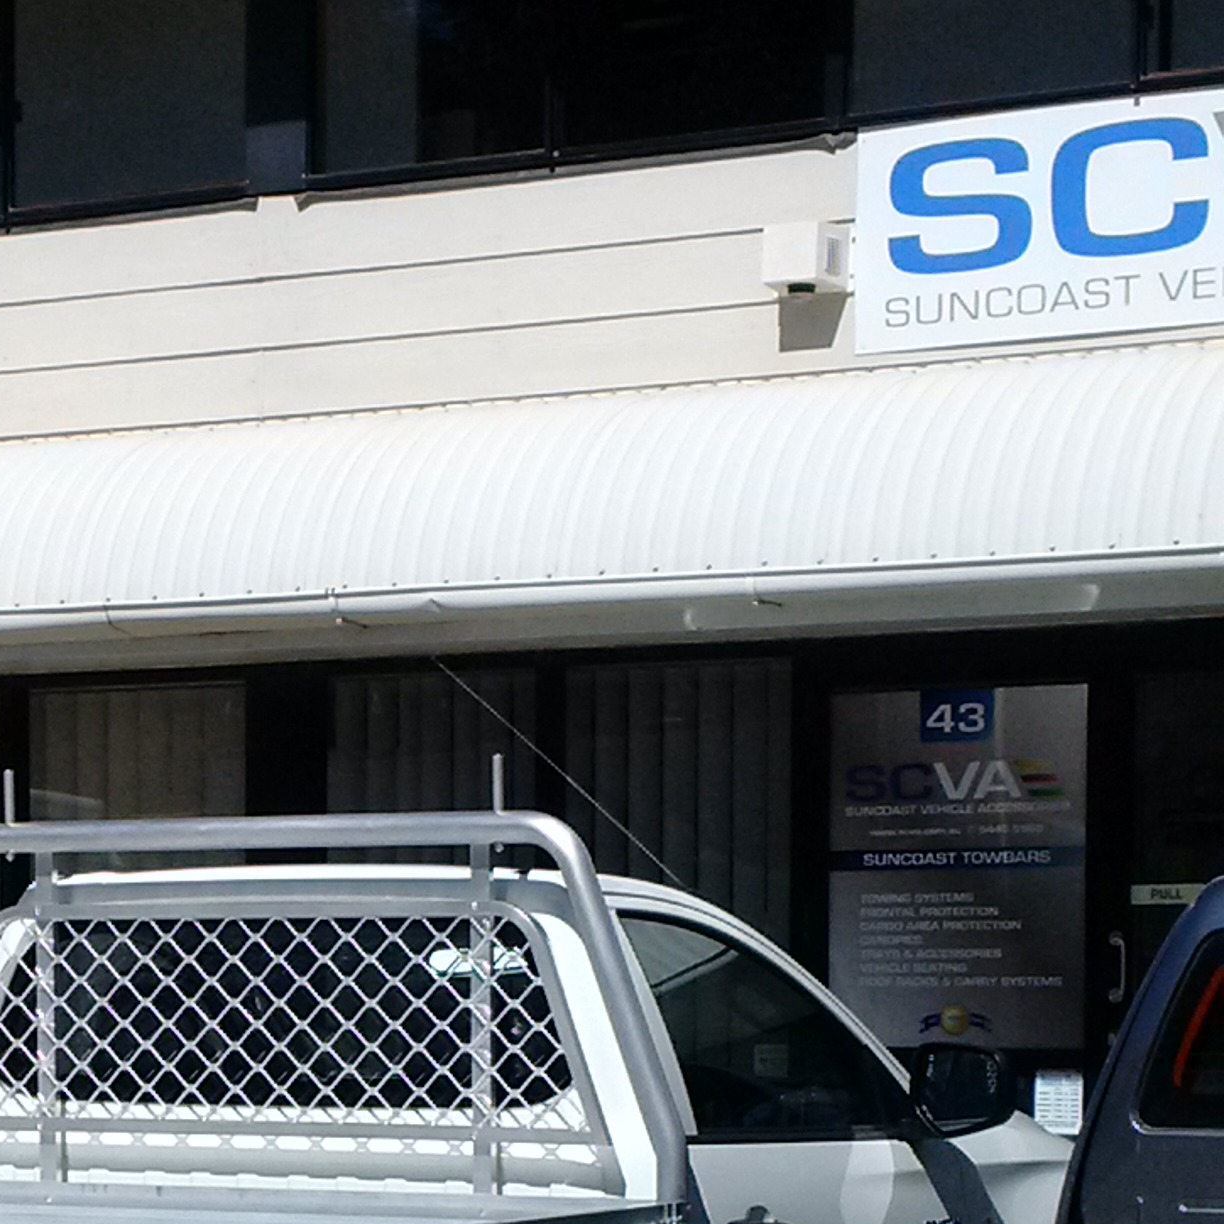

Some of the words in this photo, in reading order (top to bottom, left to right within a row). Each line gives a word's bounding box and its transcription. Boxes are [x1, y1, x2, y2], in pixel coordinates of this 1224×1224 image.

[887, 112, 1224, 275] SC
[884, 274, 1141, 328] SUNCOAST
[1158, 266, 1224, 301] VE
[925, 702, 986, 734] 43
[844, 758, 1022, 801] SCVA
[844, 804, 916, 817] SUNCOAST
[921, 803, 974, 815] VEHICLE
[863, 852, 956, 867] SUNCOAST
[963, 849, 1052, 865] TOWBARS
[1150, 887, 1183, 900] PULL
[906, 920, 938, 931] AREA
[942, 919, 1023, 930] PROTECTION
